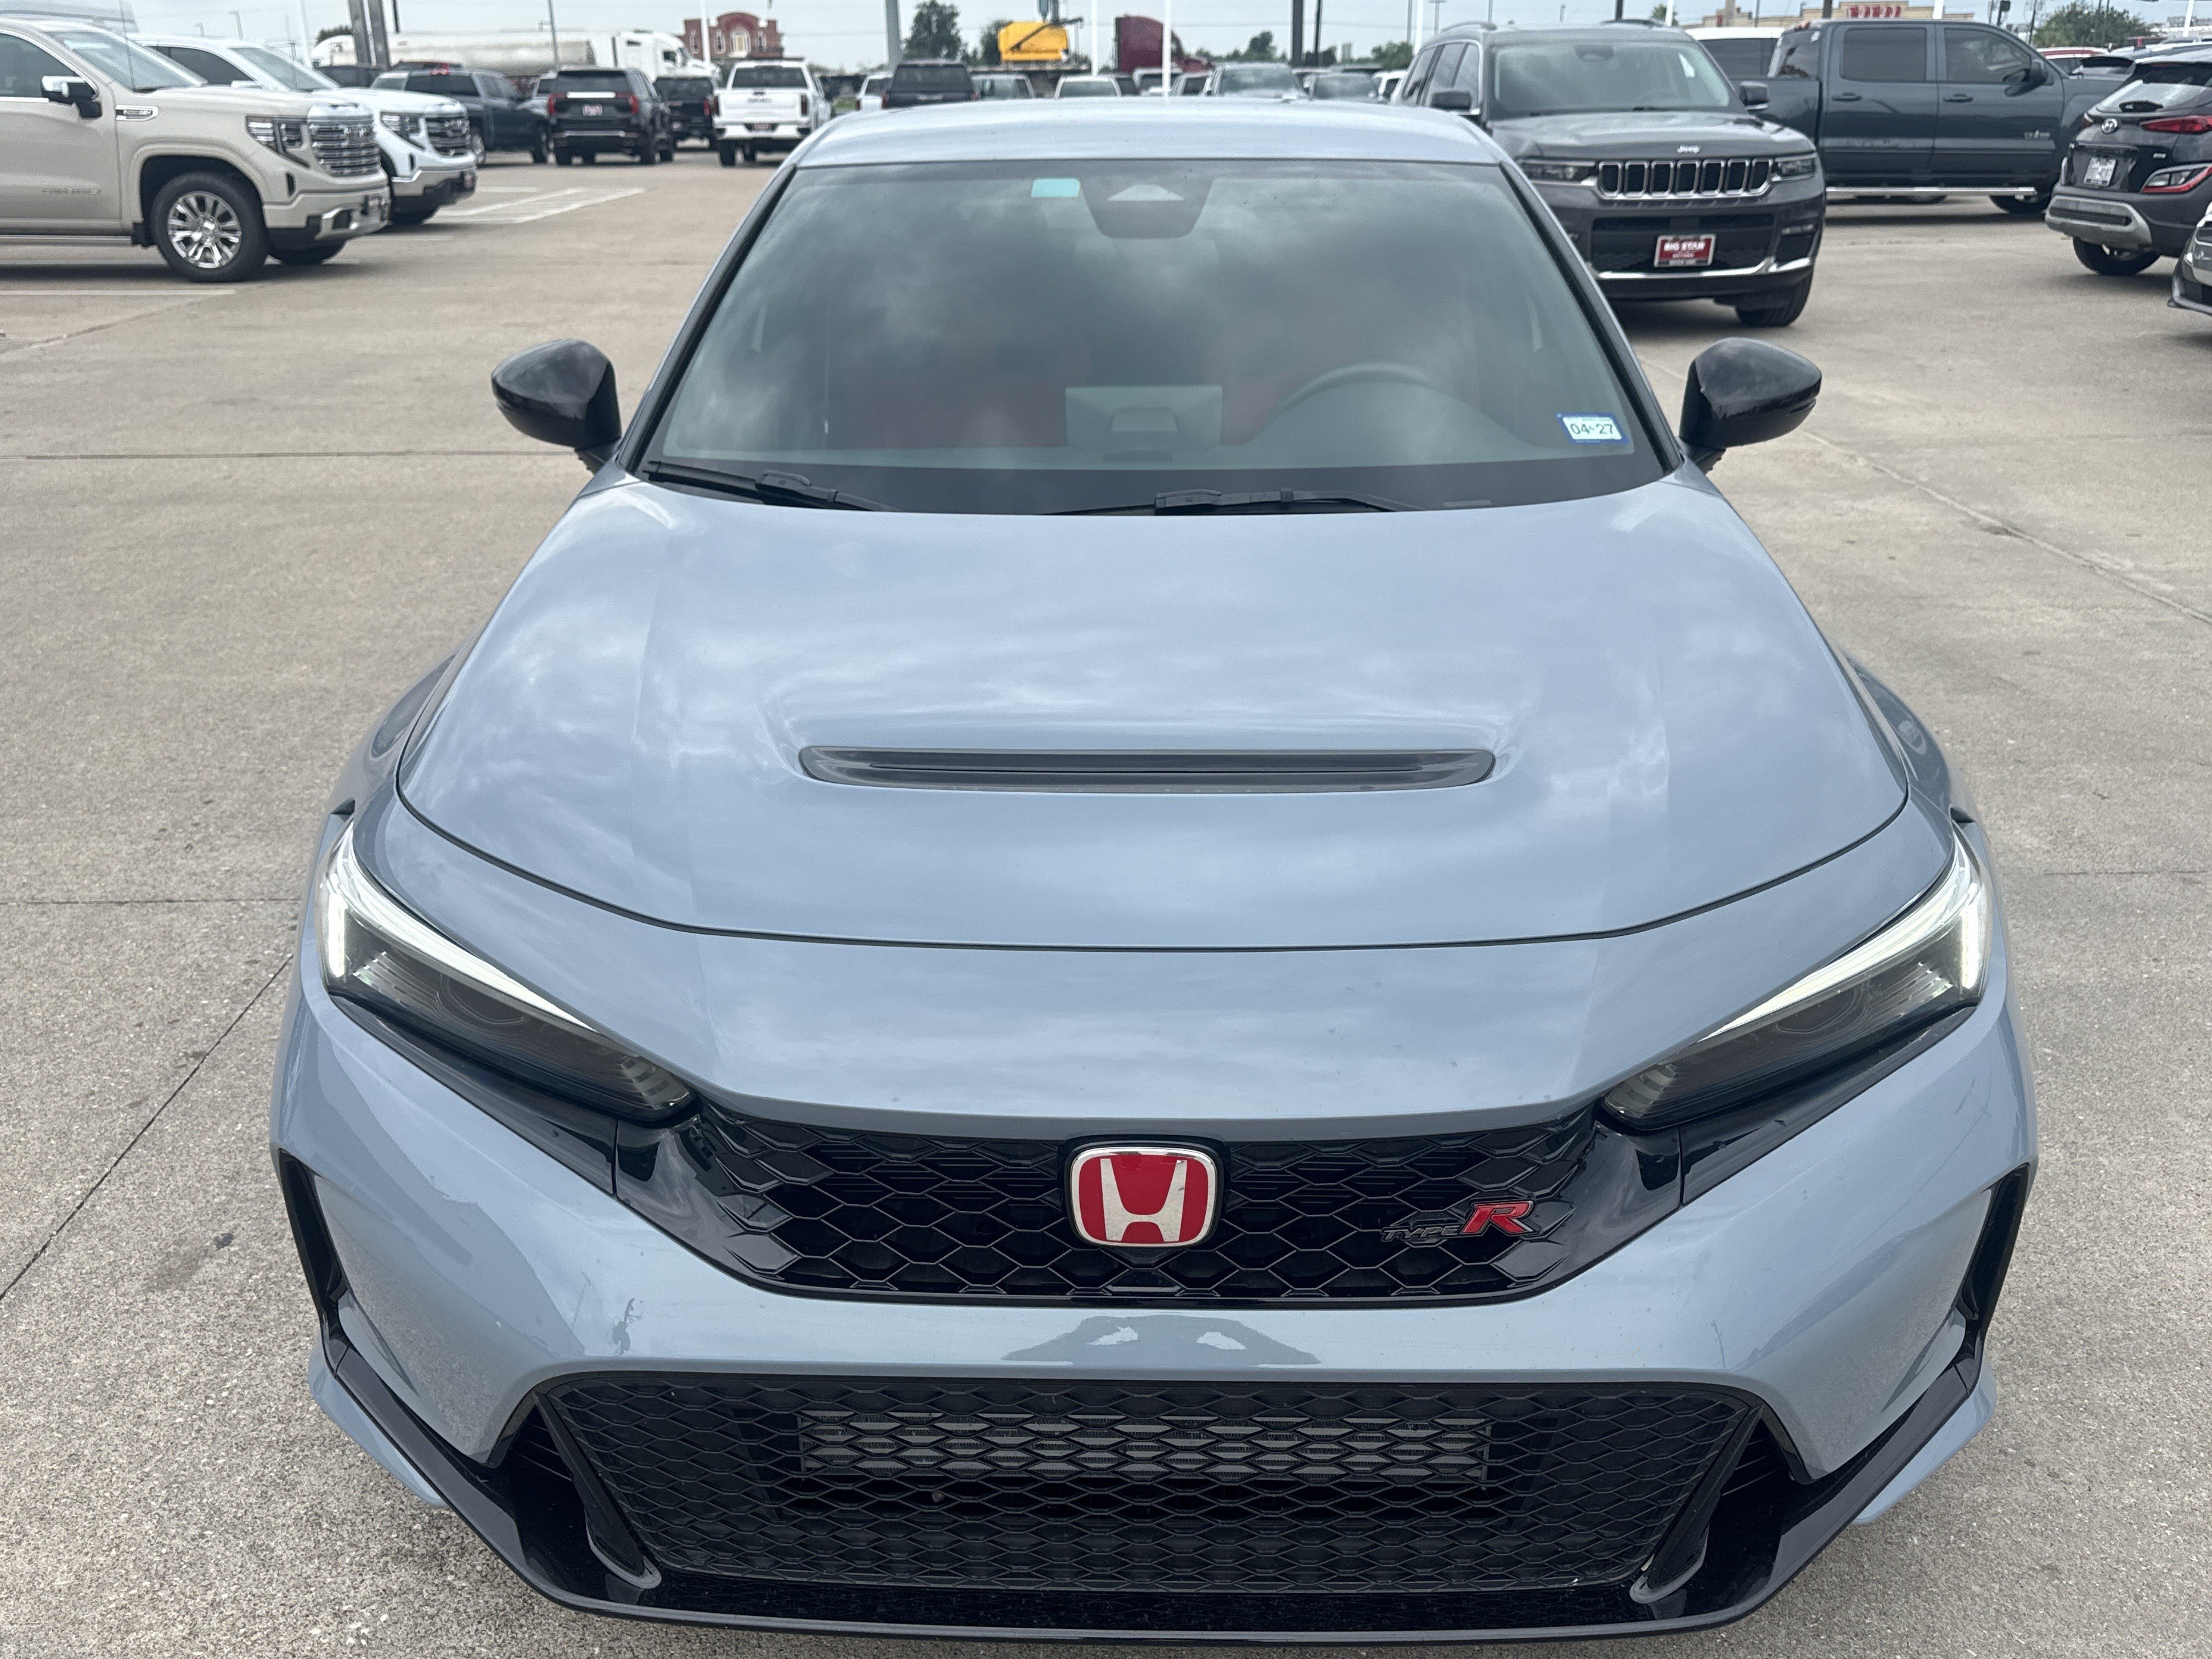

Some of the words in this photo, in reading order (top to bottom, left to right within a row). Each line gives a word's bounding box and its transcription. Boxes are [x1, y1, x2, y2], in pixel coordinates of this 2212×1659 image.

[1663, 241, 1680, 251] BIG
[1681, 241, 1706, 251] STAR
[1383, 1224, 1460, 1241] TYPE
[1460, 1200, 1534, 1234] R
